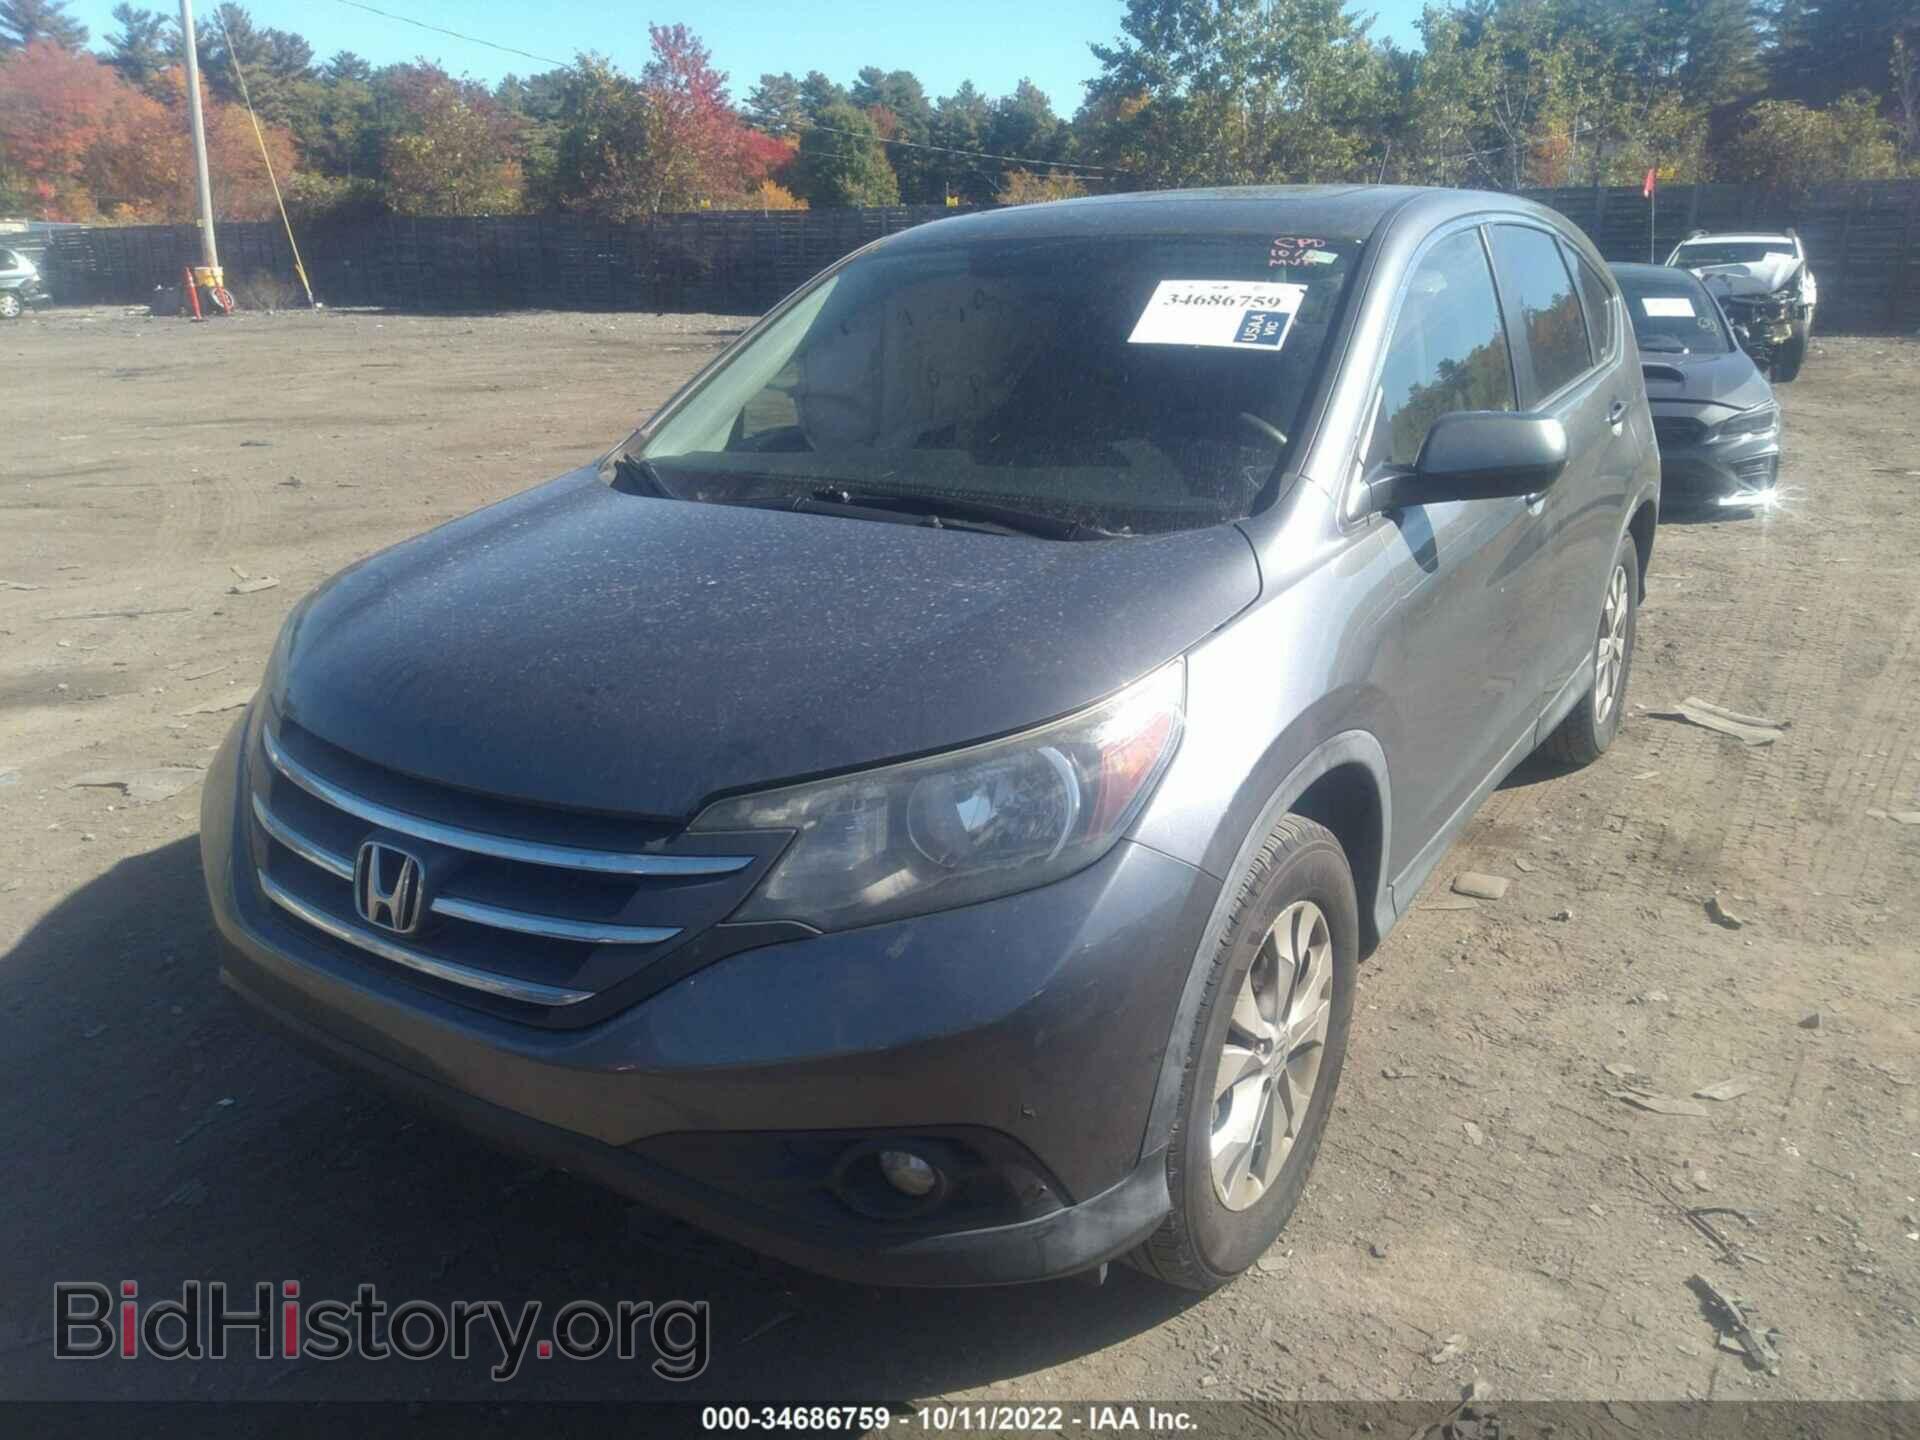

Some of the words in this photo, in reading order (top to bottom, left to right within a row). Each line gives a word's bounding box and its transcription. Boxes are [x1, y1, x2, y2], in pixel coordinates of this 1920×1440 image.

[1163, 294, 1281, 308] 34686759
[1241, 313, 1267, 341] USAA
[1263, 320, 1279, 336] VIC
